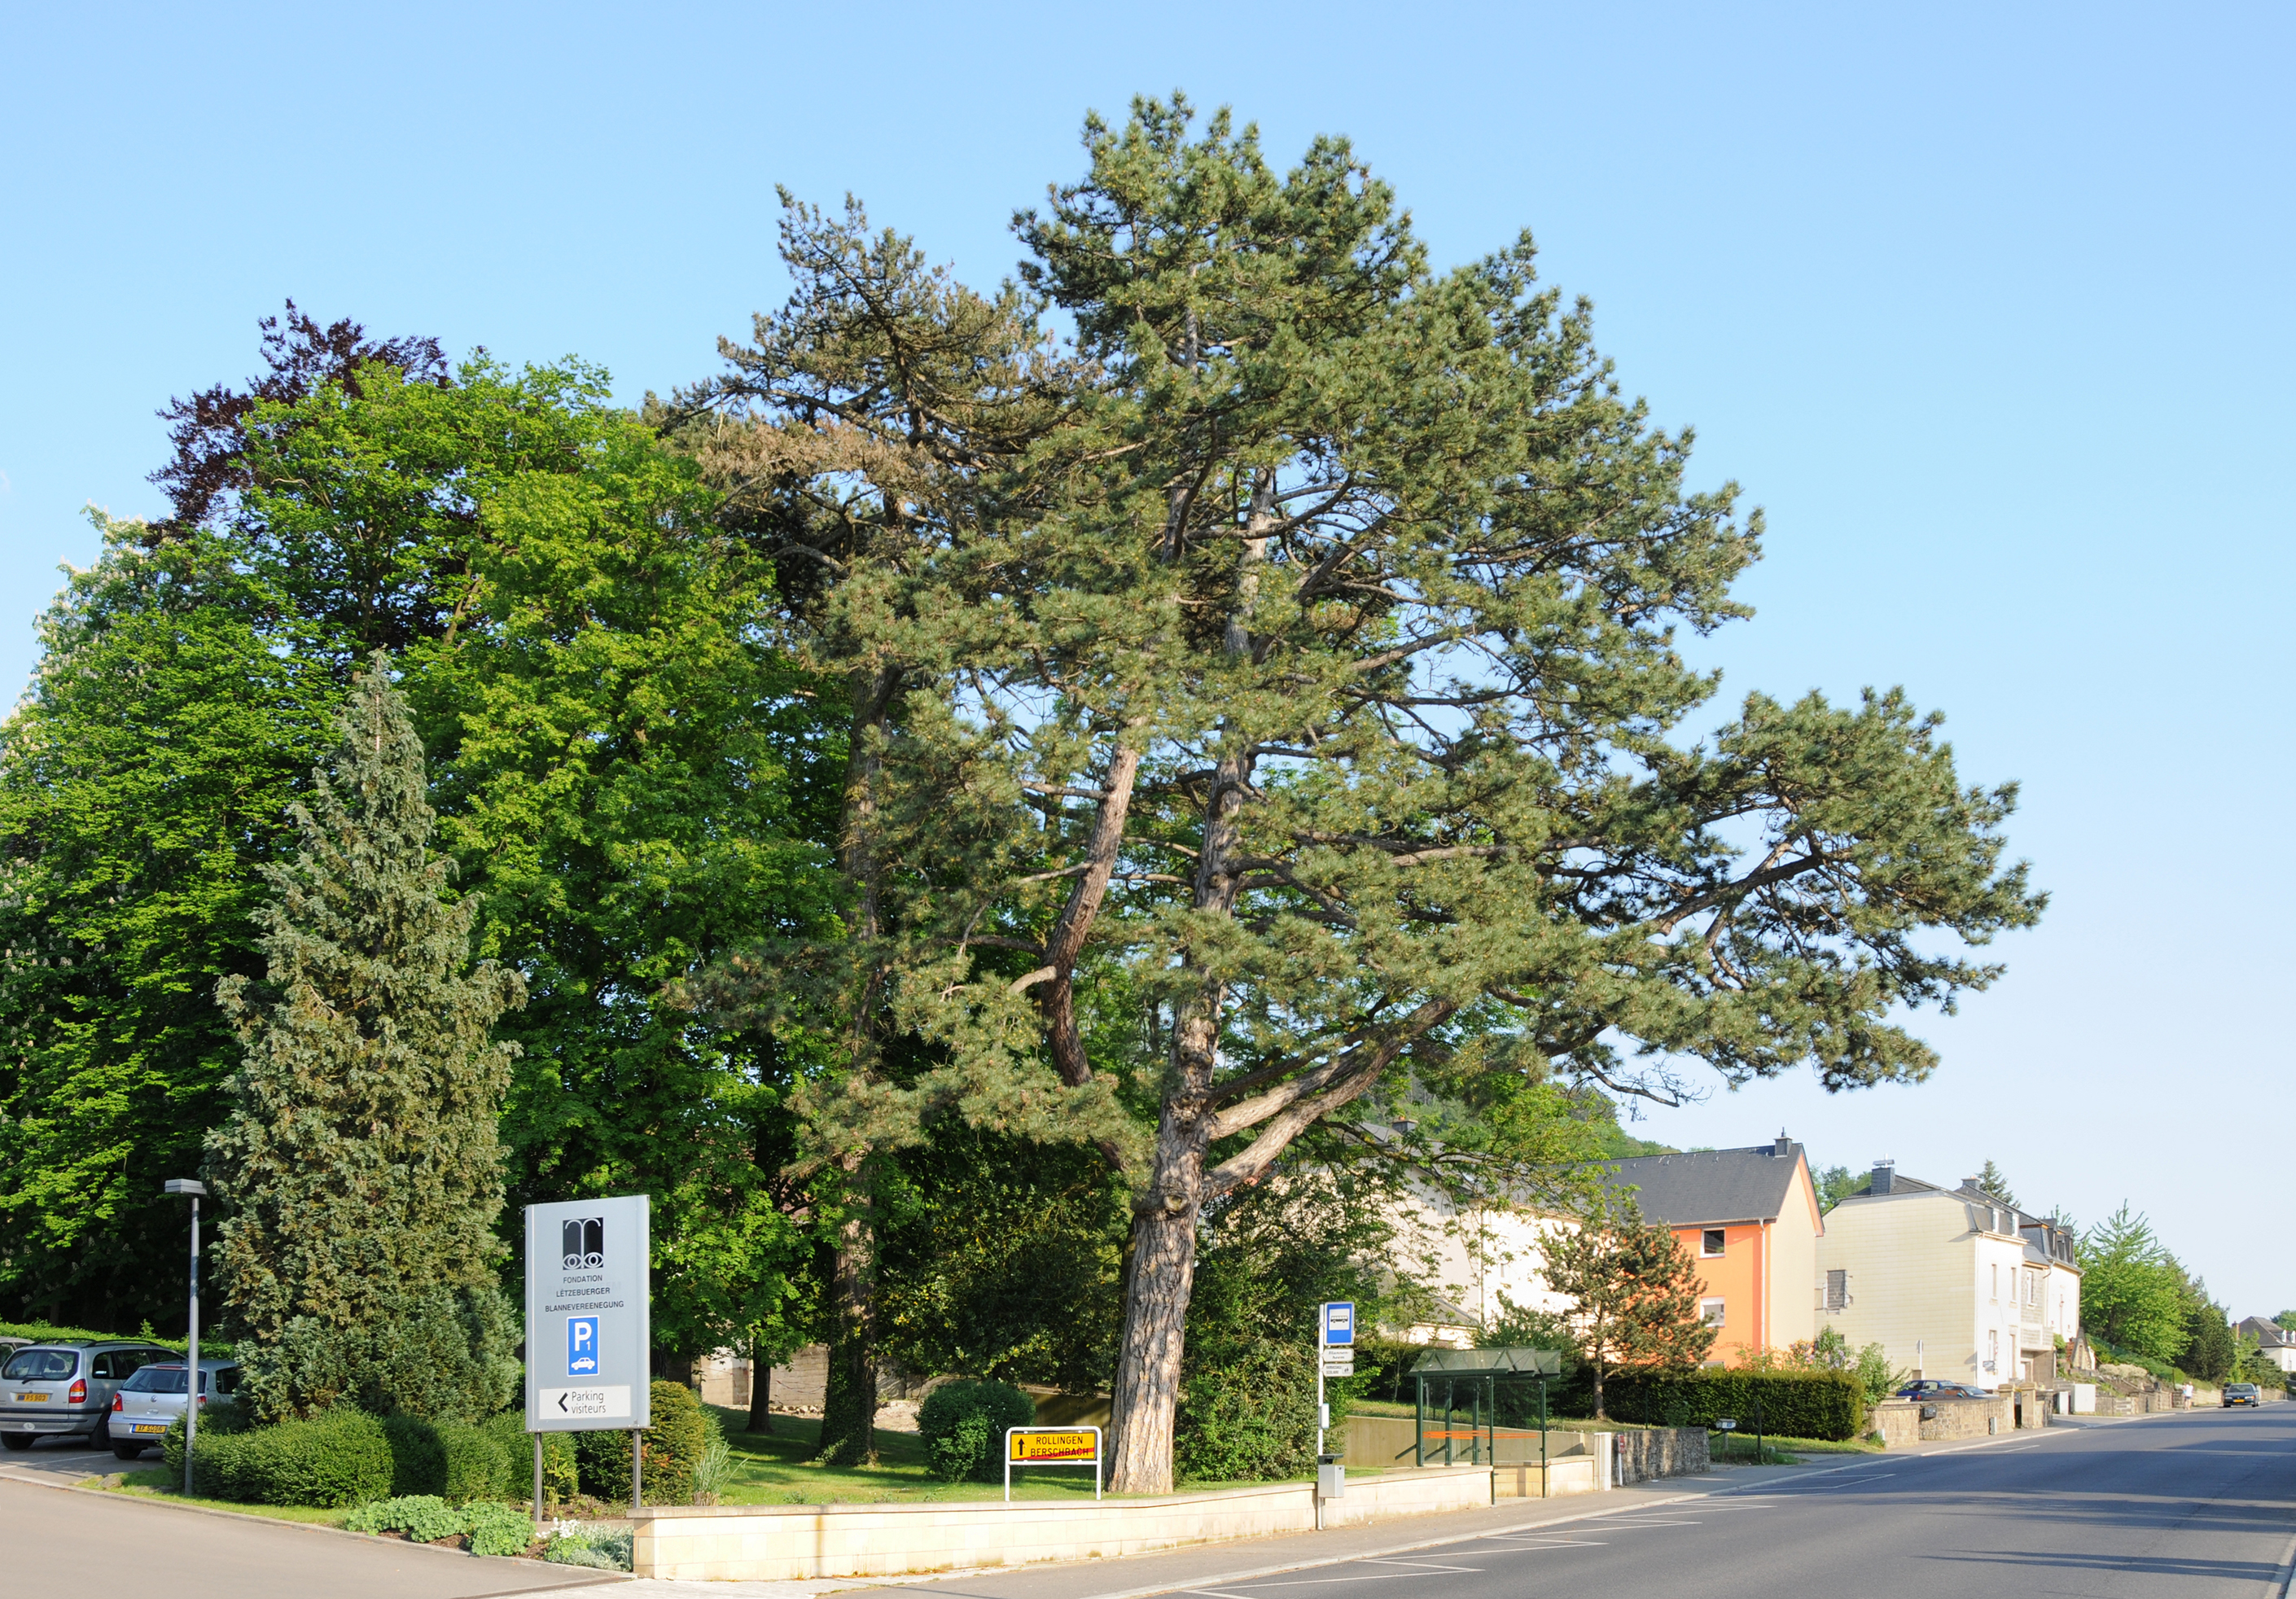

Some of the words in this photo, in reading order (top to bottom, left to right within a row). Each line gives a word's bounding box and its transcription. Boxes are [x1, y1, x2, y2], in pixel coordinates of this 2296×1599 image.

[563, 1274, 602, 1284] FONDATION
[556, 1287, 611, 1298] LËTZEBUERGER
[545, 1300, 624, 1312] BLANNEVEREENEGUNG
[572, 1391, 604, 1404] Parking
[571, 1403, 607, 1414] visiteurs
[1036, 1436, 1084, 1445] ROLLINGEN
[1030, 1448, 1089, 1457] BERSCHBACH
